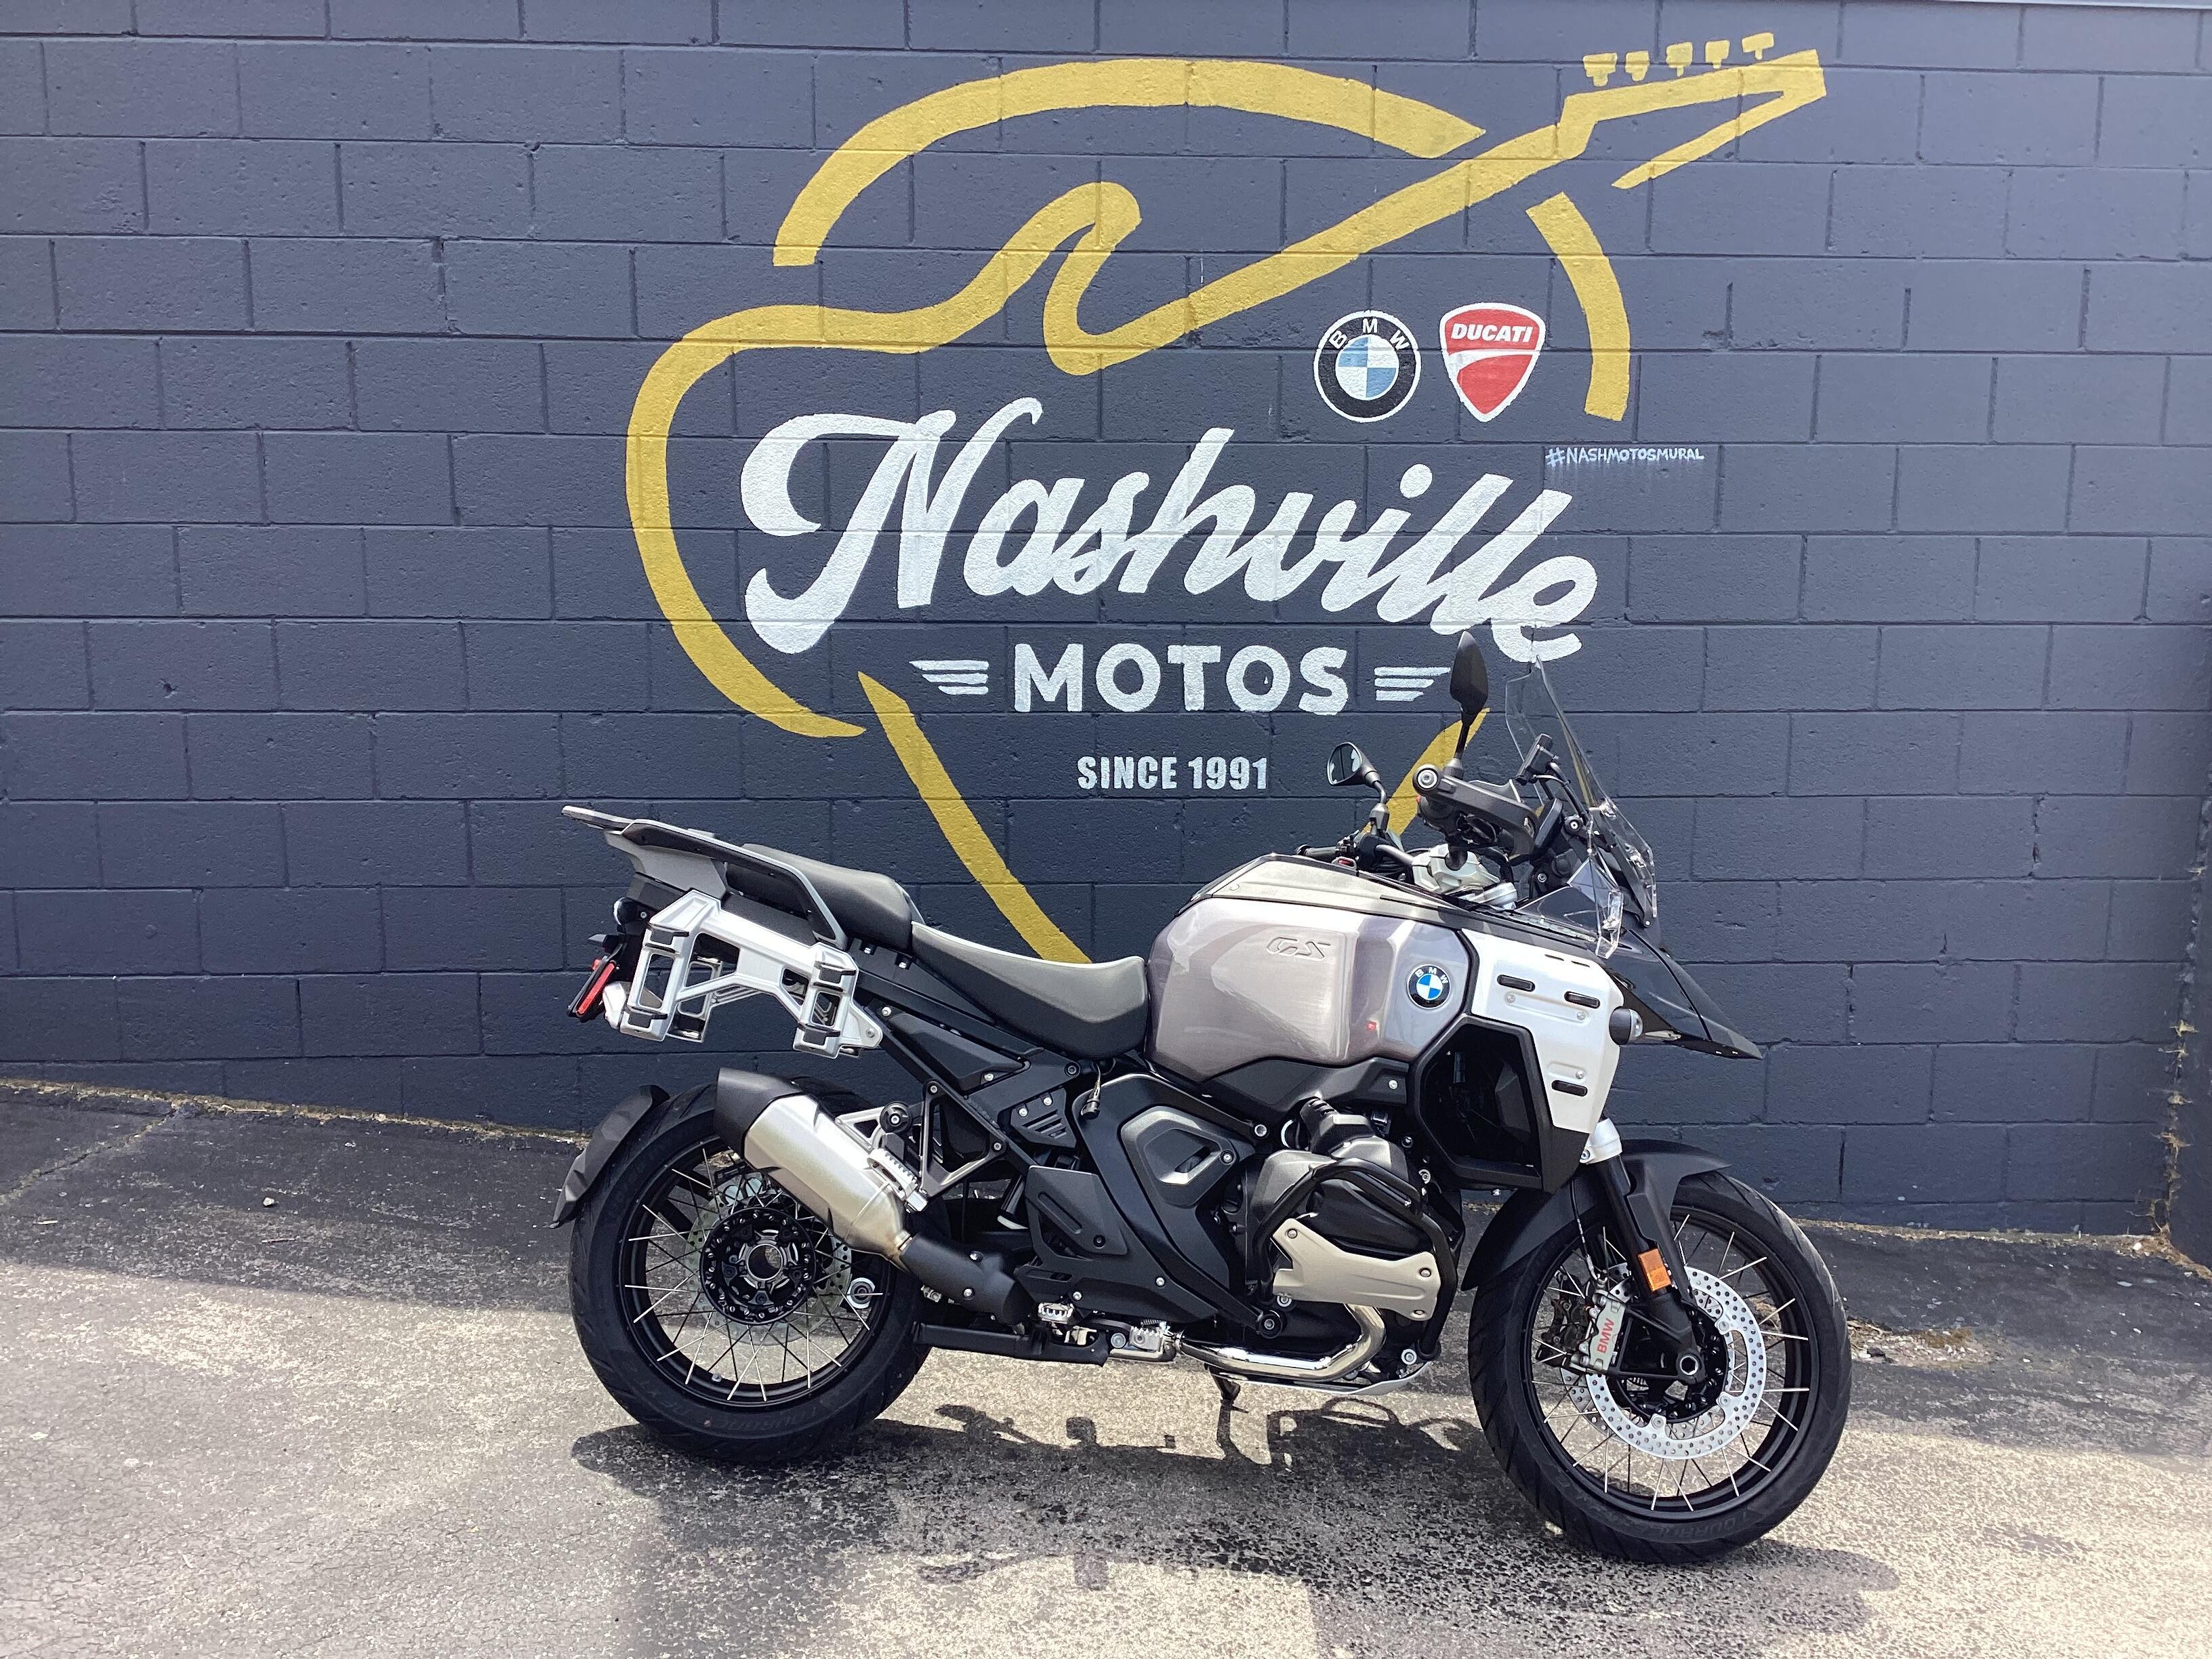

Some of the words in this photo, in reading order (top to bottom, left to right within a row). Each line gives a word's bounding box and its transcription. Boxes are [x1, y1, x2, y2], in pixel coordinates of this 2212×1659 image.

[1329, 318, 1410, 350] BMW
[1451, 323, 1534, 344] DUCATI
[1544, 447, 1705, 467] #NASHMOTOSMURAL
[741, 397, 1597, 663] Nashville
[1014, 642, 1349, 716] MOTOS
[1077, 756, 1177, 790] SINCE
[1188, 756, 1267, 790] 1991
[1265, 937, 1332, 962] GS
[1414, 966, 1449, 985] BMW
[1597, 1317, 1615, 1354] BMW
